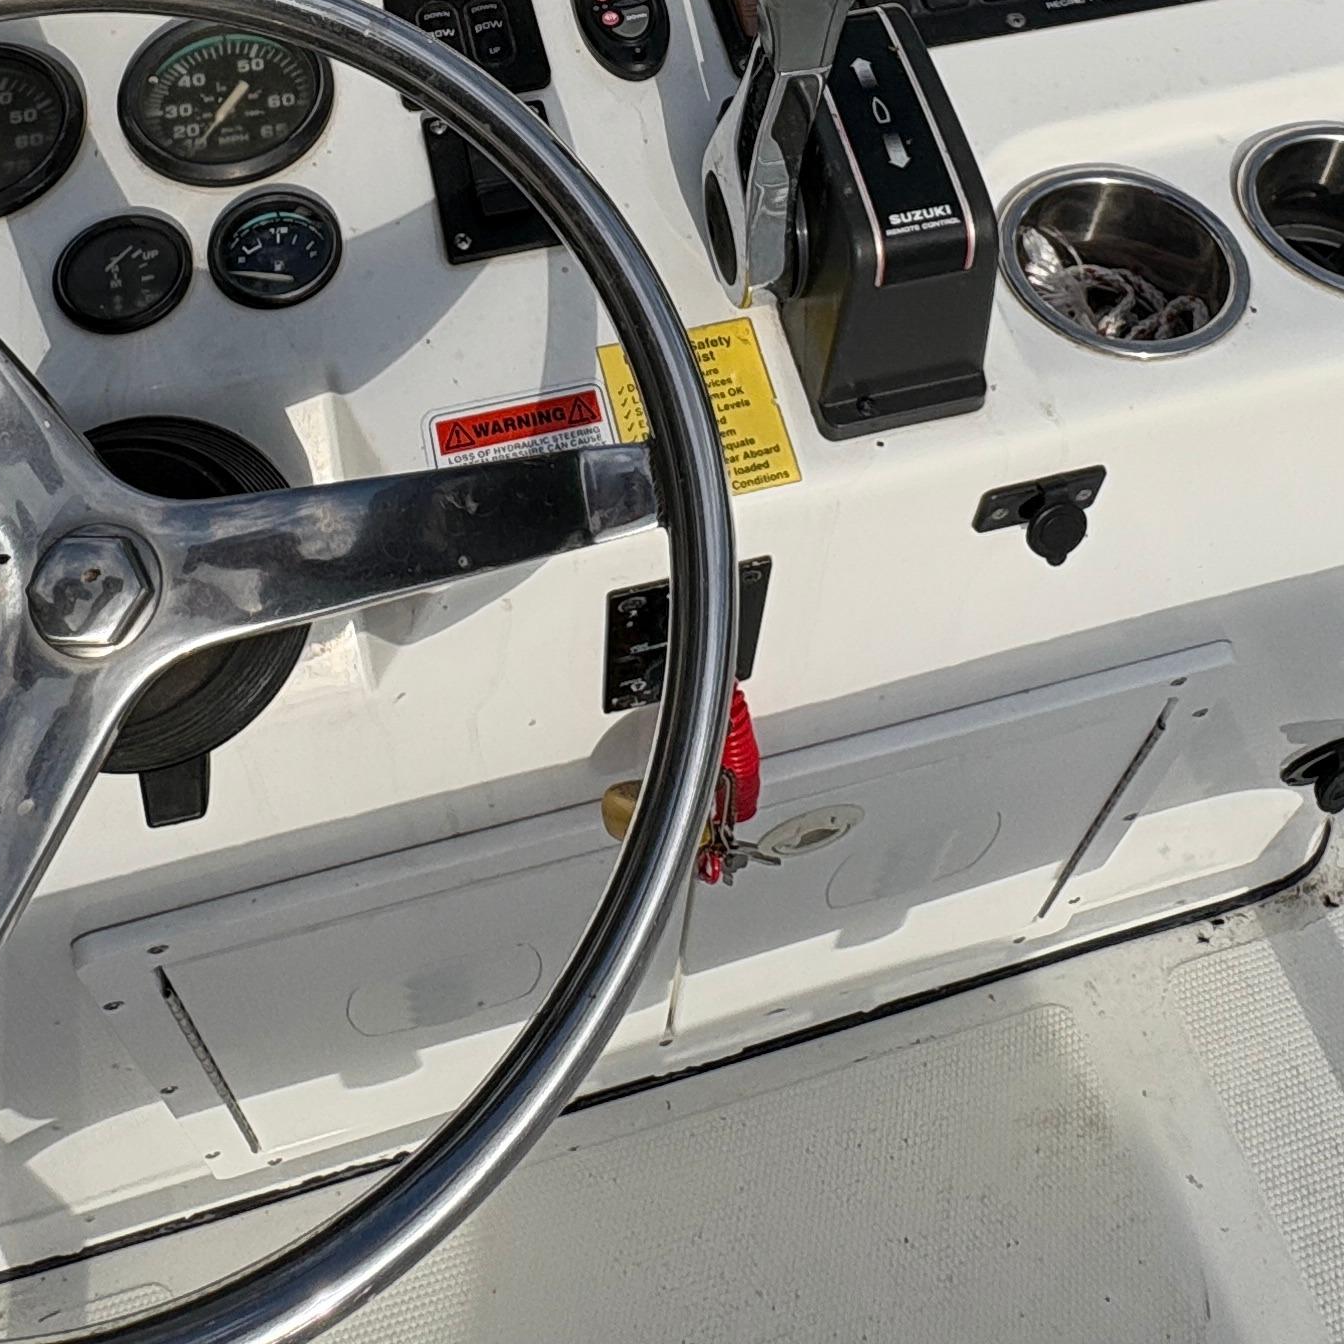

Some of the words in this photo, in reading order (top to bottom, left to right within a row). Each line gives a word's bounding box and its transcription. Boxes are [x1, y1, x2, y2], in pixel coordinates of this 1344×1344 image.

[474, 20, 503, 34] BOW
[237, 58, 264, 73] 50
[178, 73, 206, 88] 40
[267, 93, 296, 108] 60
[9, 108, 38, 124] 50
[165, 103, 193, 119] 30
[173, 123, 200, 139] 20
[260, 123, 289, 138] 65
[14, 133, 44, 149] 60
[888, 204, 952, 225] SUZUKI
[690, 335, 732, 352] Safety
[707, 375, 733, 389] vices
[728, 386, 745, 397] OK
[717, 398, 751, 413] Levels
[472, 407, 566, 439] WARNING
[448, 452, 476, 465] LOSS
[477, 448, 491, 459] OF
[493, 437, 550, 456] HYDRAULIC
[552, 425, 601, 444] STEERING
[547, 442, 569, 453] CAN
[570, 435, 603, 448] CAUSE
[722, 436, 756, 452] quate
[743, 444, 781, 460] Aboard
[734, 460, 770, 476] loaded
[731, 469, 790, 490] Conditions
